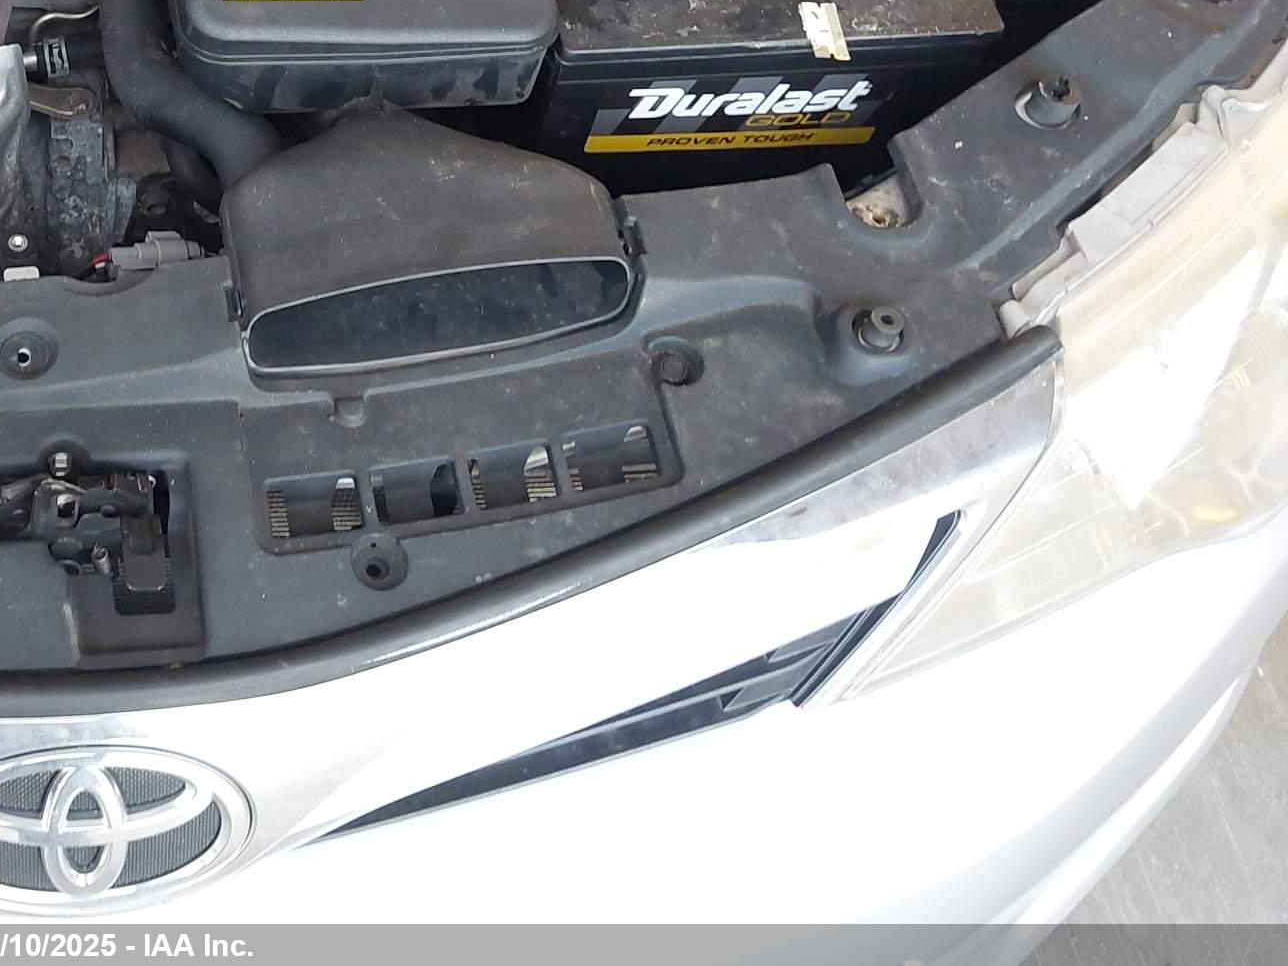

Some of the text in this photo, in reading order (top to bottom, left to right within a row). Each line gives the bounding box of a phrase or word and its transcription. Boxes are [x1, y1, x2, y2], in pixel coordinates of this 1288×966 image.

[628, 80, 872, 120] Duralast
[745, 111, 851, 127] GOLD
[647, 132, 814, 147] PROVEN TOUGH
